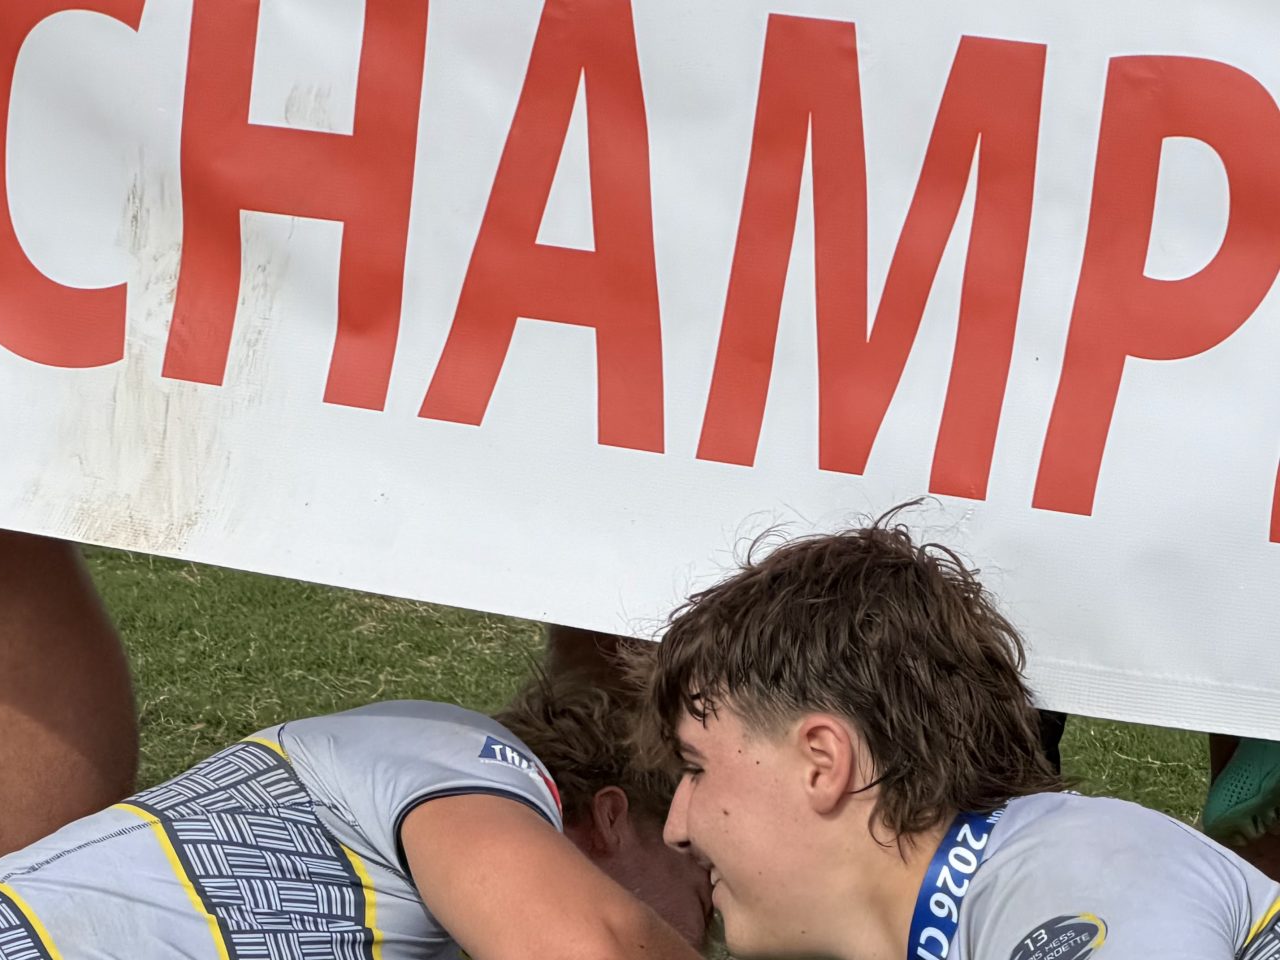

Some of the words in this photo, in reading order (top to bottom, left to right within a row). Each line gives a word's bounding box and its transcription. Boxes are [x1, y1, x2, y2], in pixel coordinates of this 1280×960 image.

[928, 823, 988, 922] 2026
[1024, 929, 1048, 951] 13
[1045, 930, 1076, 952] HESS
